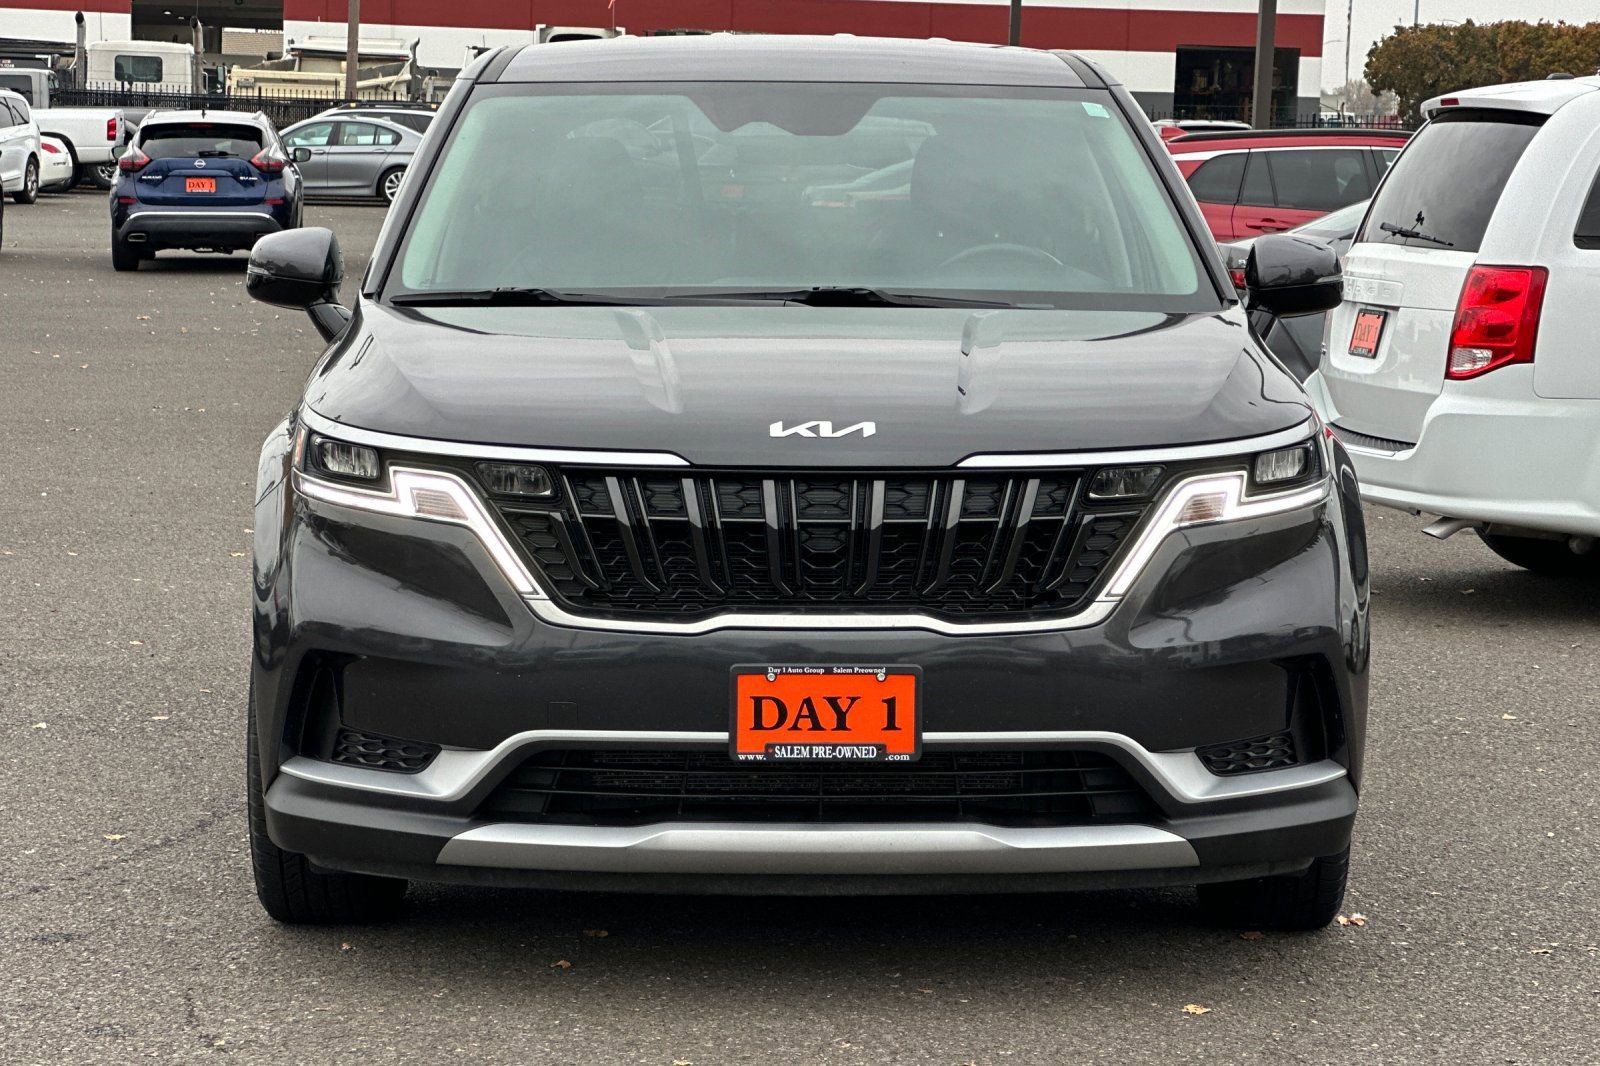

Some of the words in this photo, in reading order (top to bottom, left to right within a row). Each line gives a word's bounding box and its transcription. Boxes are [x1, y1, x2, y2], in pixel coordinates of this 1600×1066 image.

[188, 181, 206, 189] DAY
[209, 181, 213, 189] 1
[749, 696, 861, 731] DAY
[881, 696, 902, 731] 1
[774, 745, 809, 758] SALEM
[812, 745, 877, 758] PRE-OWNED
